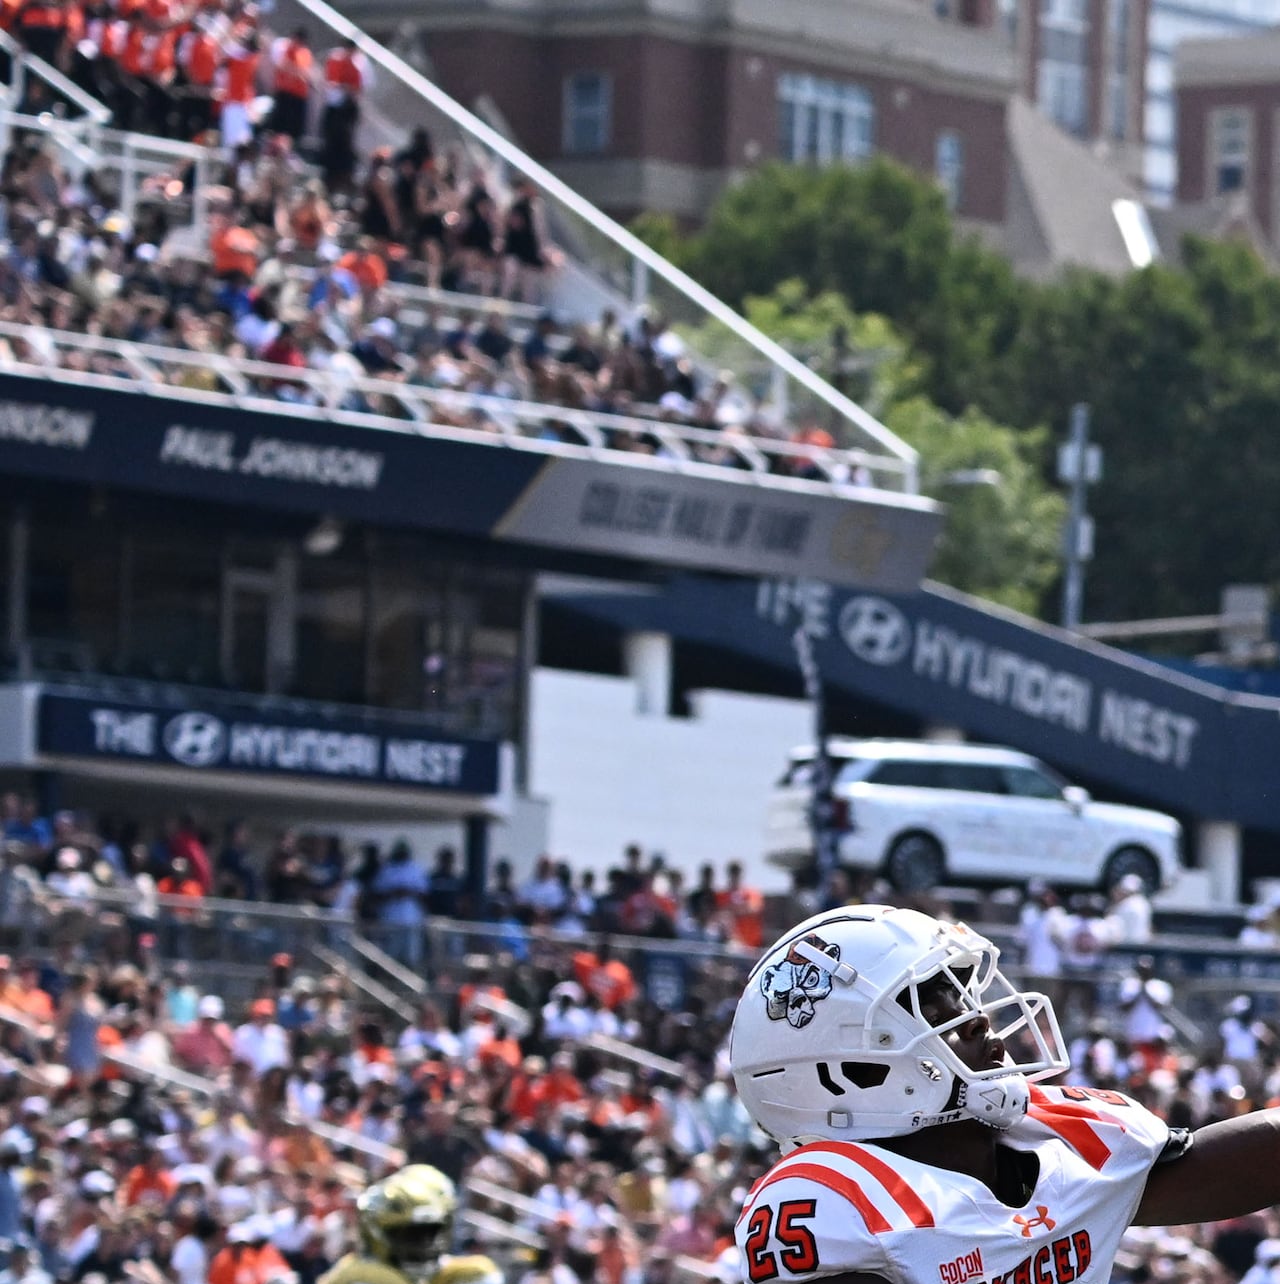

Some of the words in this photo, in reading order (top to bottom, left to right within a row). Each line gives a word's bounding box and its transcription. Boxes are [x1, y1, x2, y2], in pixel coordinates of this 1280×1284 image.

[160, 424, 236, 472] PAUL
[239, 437, 384, 490] JOHNSON
[911, 618, 1094, 736] HYUNDAI
[1099, 690, 1199, 768] NEST
[91, 708, 157, 757] THE
[228, 722, 378, 778] HYUNDAI
[384, 737, 466, 787] NEST
[745, 1198, 820, 1283] 25
